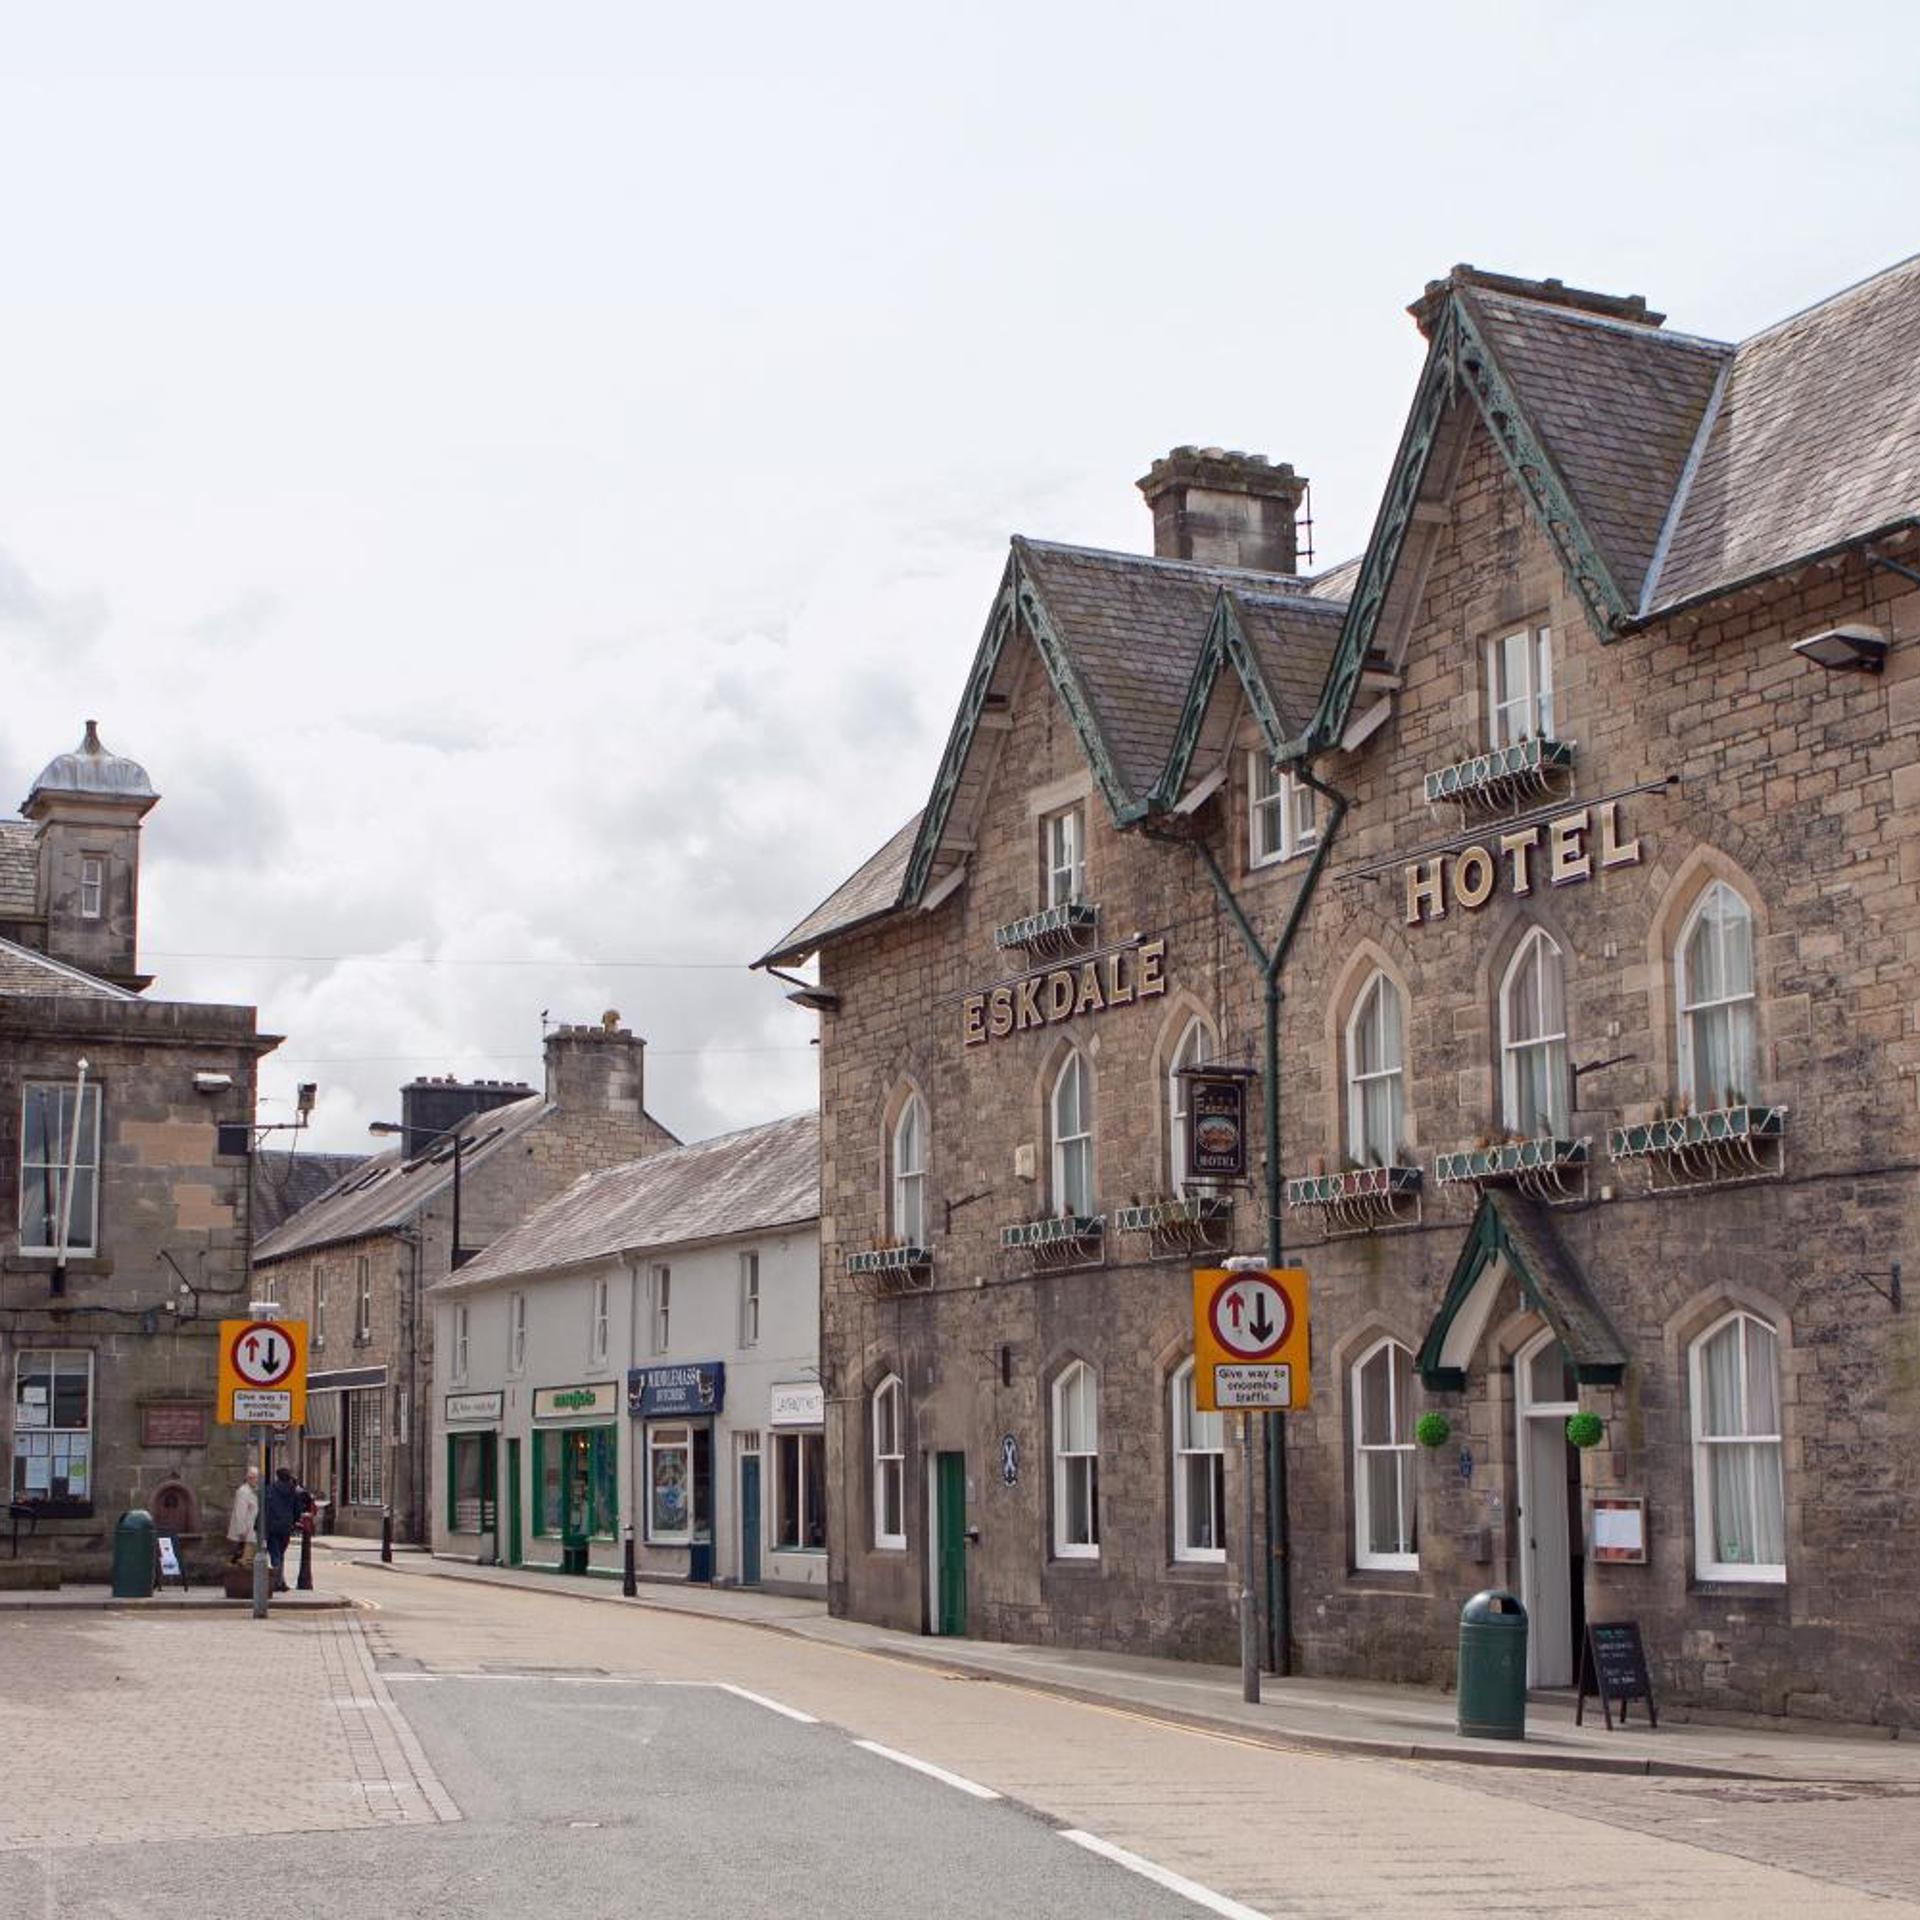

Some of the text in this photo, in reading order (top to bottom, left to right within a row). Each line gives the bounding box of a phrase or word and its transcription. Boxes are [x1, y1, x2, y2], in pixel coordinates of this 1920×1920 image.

[1405, 801, 1641, 924] HOTEL
[963, 938, 1167, 1046] ESKDALE
[1219, 1368, 1286, 1379] Give way to
[1227, 1381, 1279, 1391] oncoming
[1235, 1392, 1270, 1402] traffic
